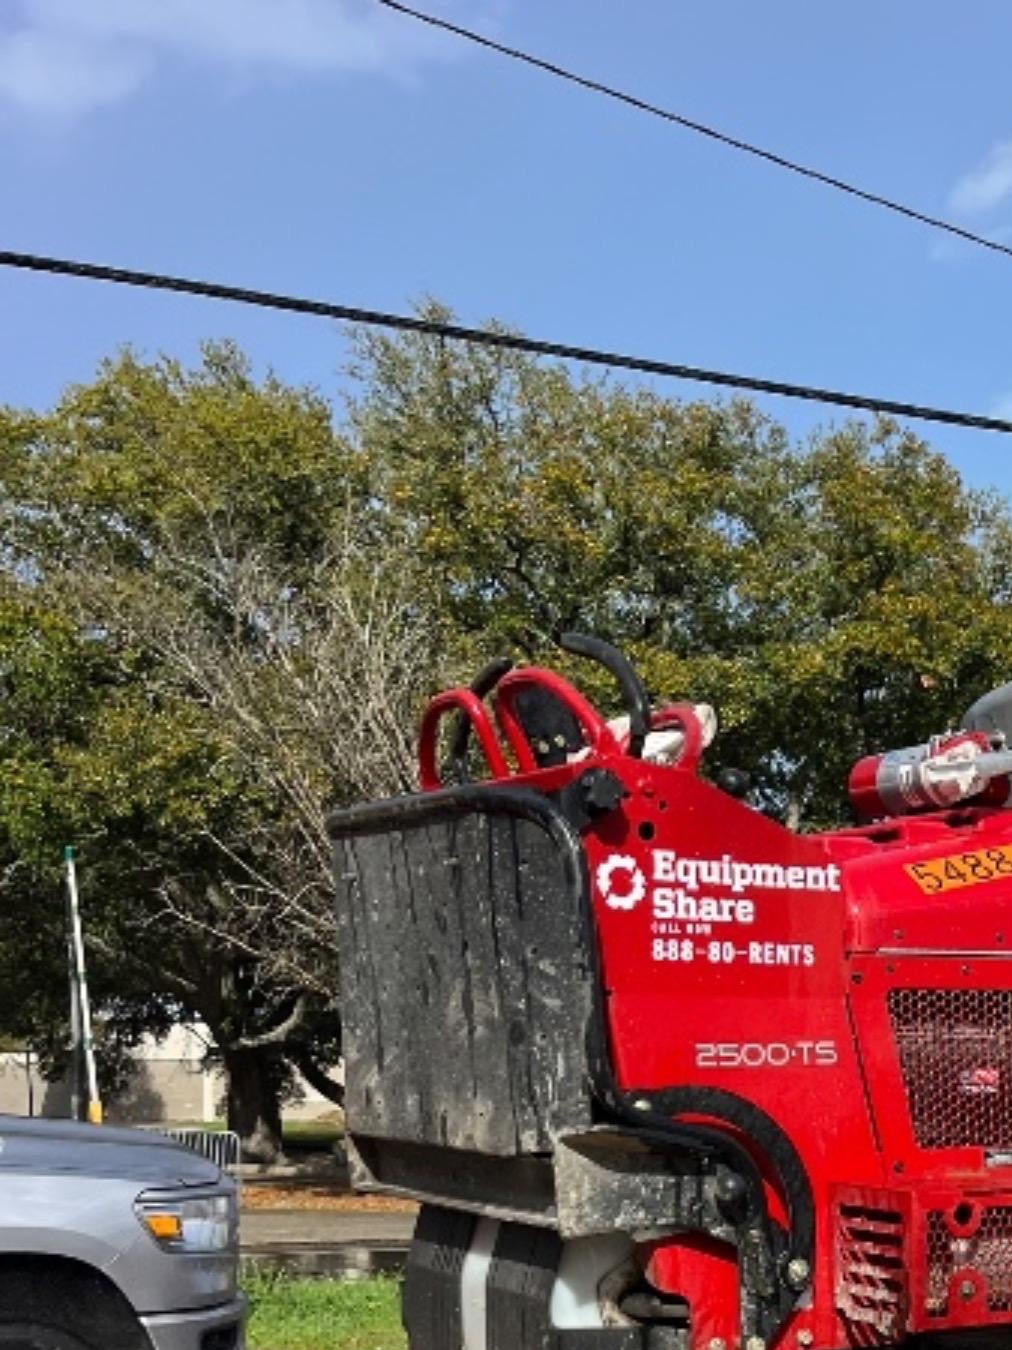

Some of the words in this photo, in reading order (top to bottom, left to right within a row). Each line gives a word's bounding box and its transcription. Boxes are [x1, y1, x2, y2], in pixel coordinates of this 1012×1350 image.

[652, 849, 841, 892] Equipment
[653, 887, 755, 923] Share
[652, 938, 815, 966] 888-80-RENTS
